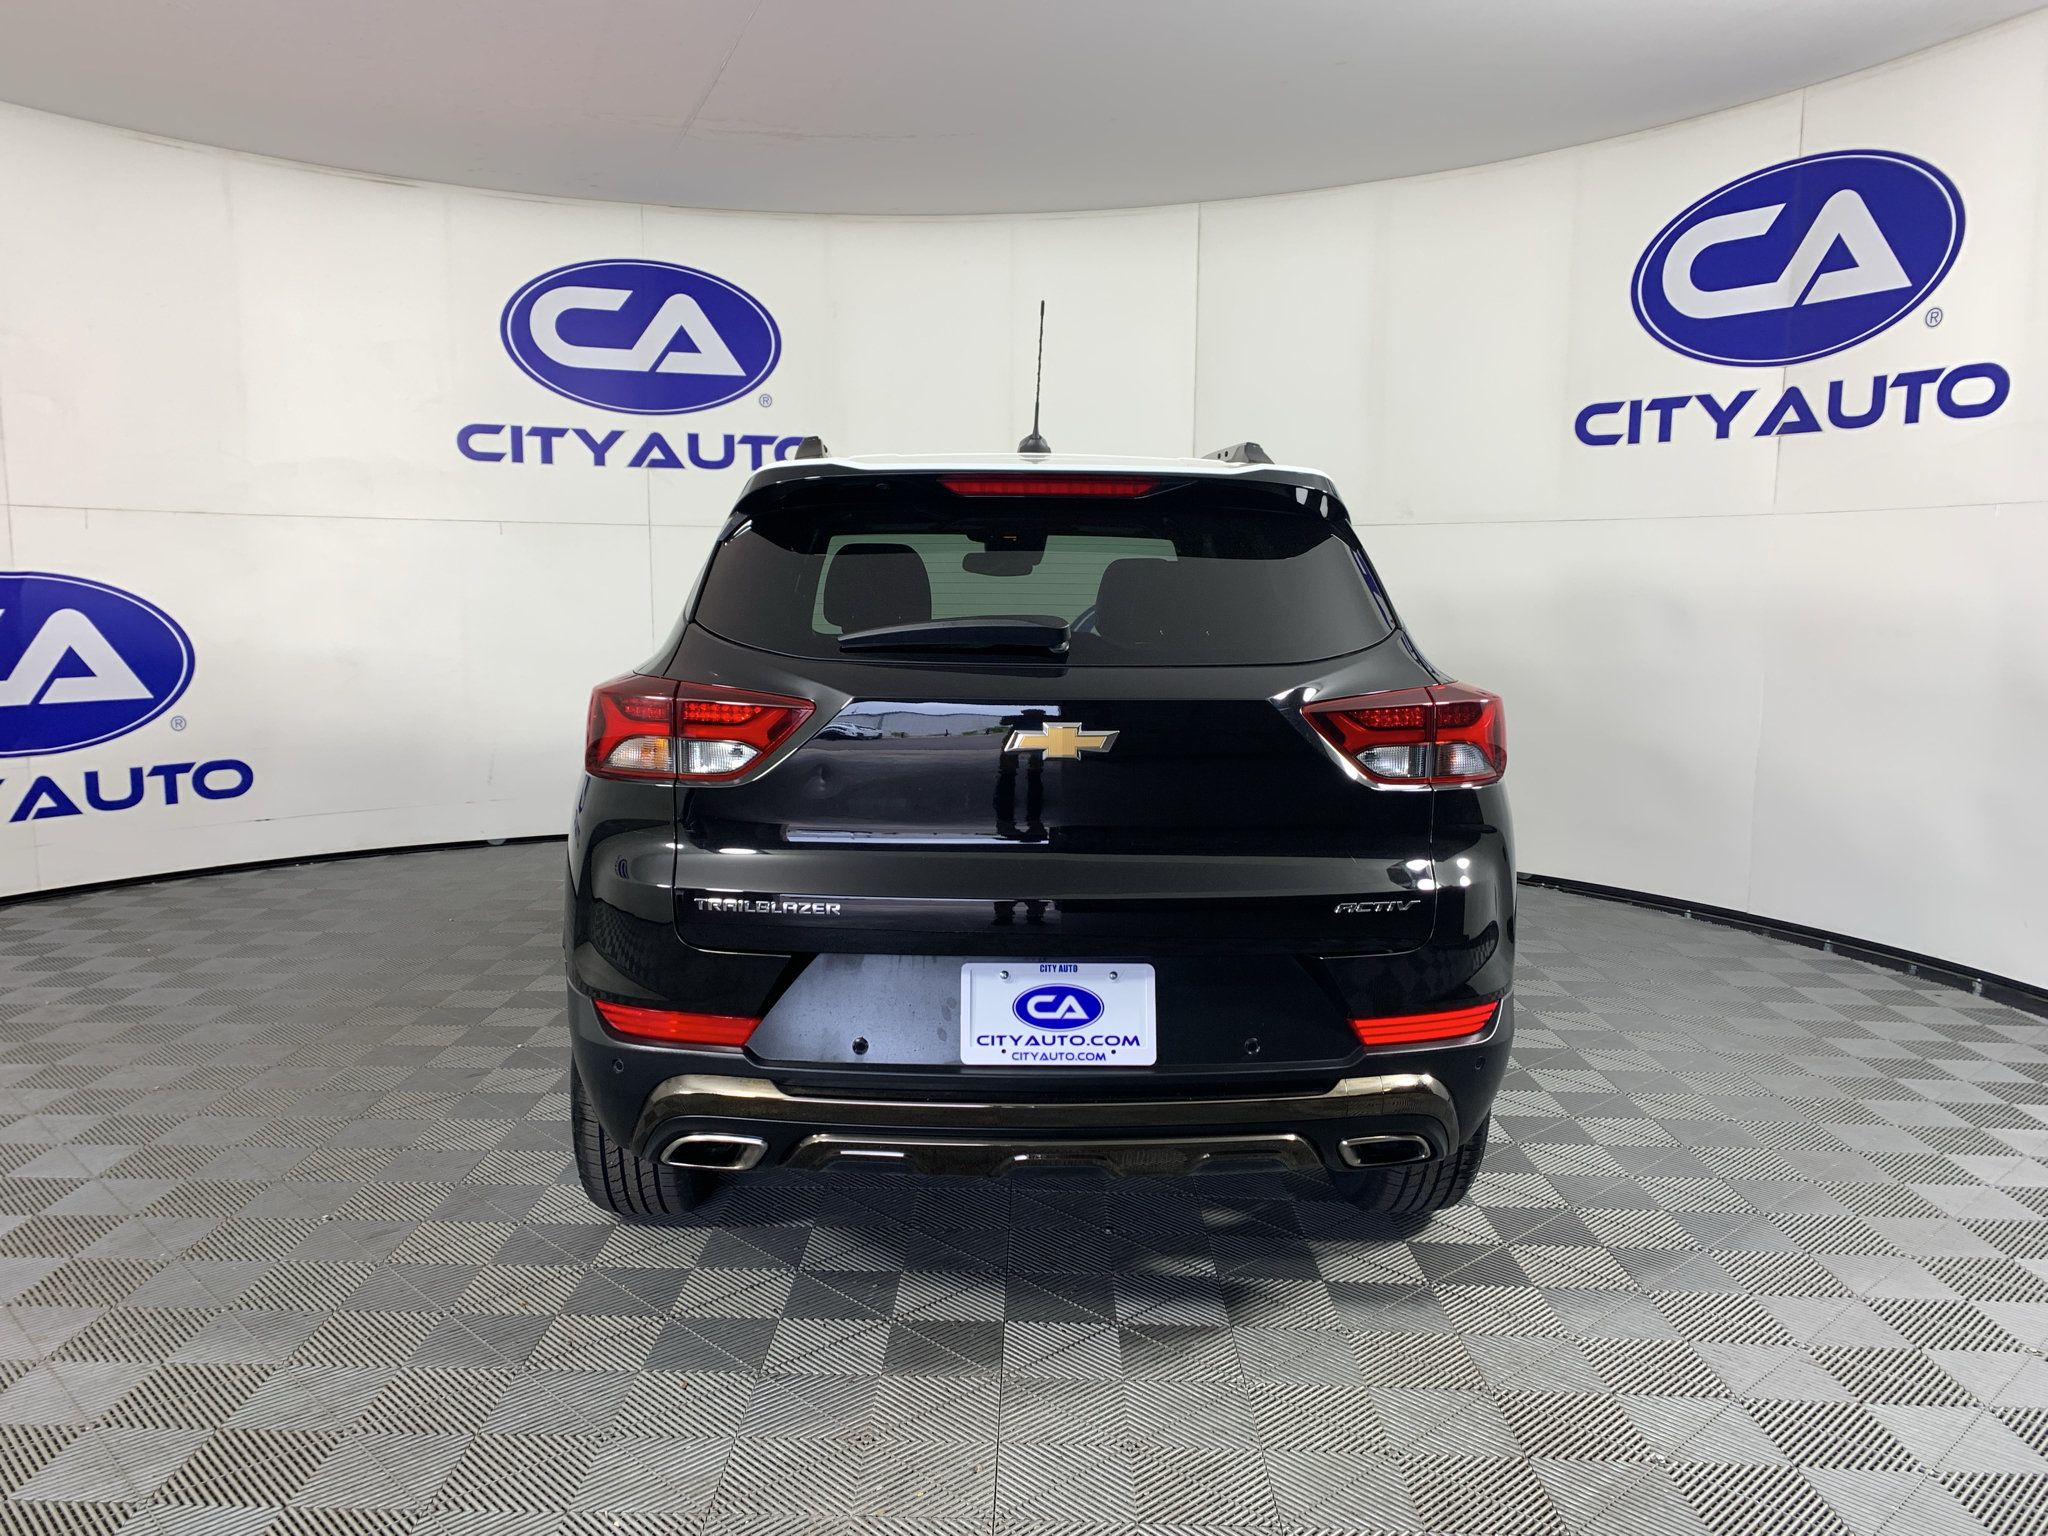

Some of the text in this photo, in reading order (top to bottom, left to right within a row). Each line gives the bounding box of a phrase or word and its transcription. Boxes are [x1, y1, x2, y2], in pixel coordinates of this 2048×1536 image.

[1661, 188, 1914, 320] CA
[529, 285, 748, 377] CA
[693, 897, 842, 916] TRAILBLAZER
[1333, 899, 1422, 914] ACTIV
[1039, 964, 1078, 973] CITY AUTO
[1026, 994, 1090, 1020] CA
[976, 1034, 1141, 1047] CITYAUTO.COM
[1011, 1051, 1107, 1062] CITYAUTO.COM
